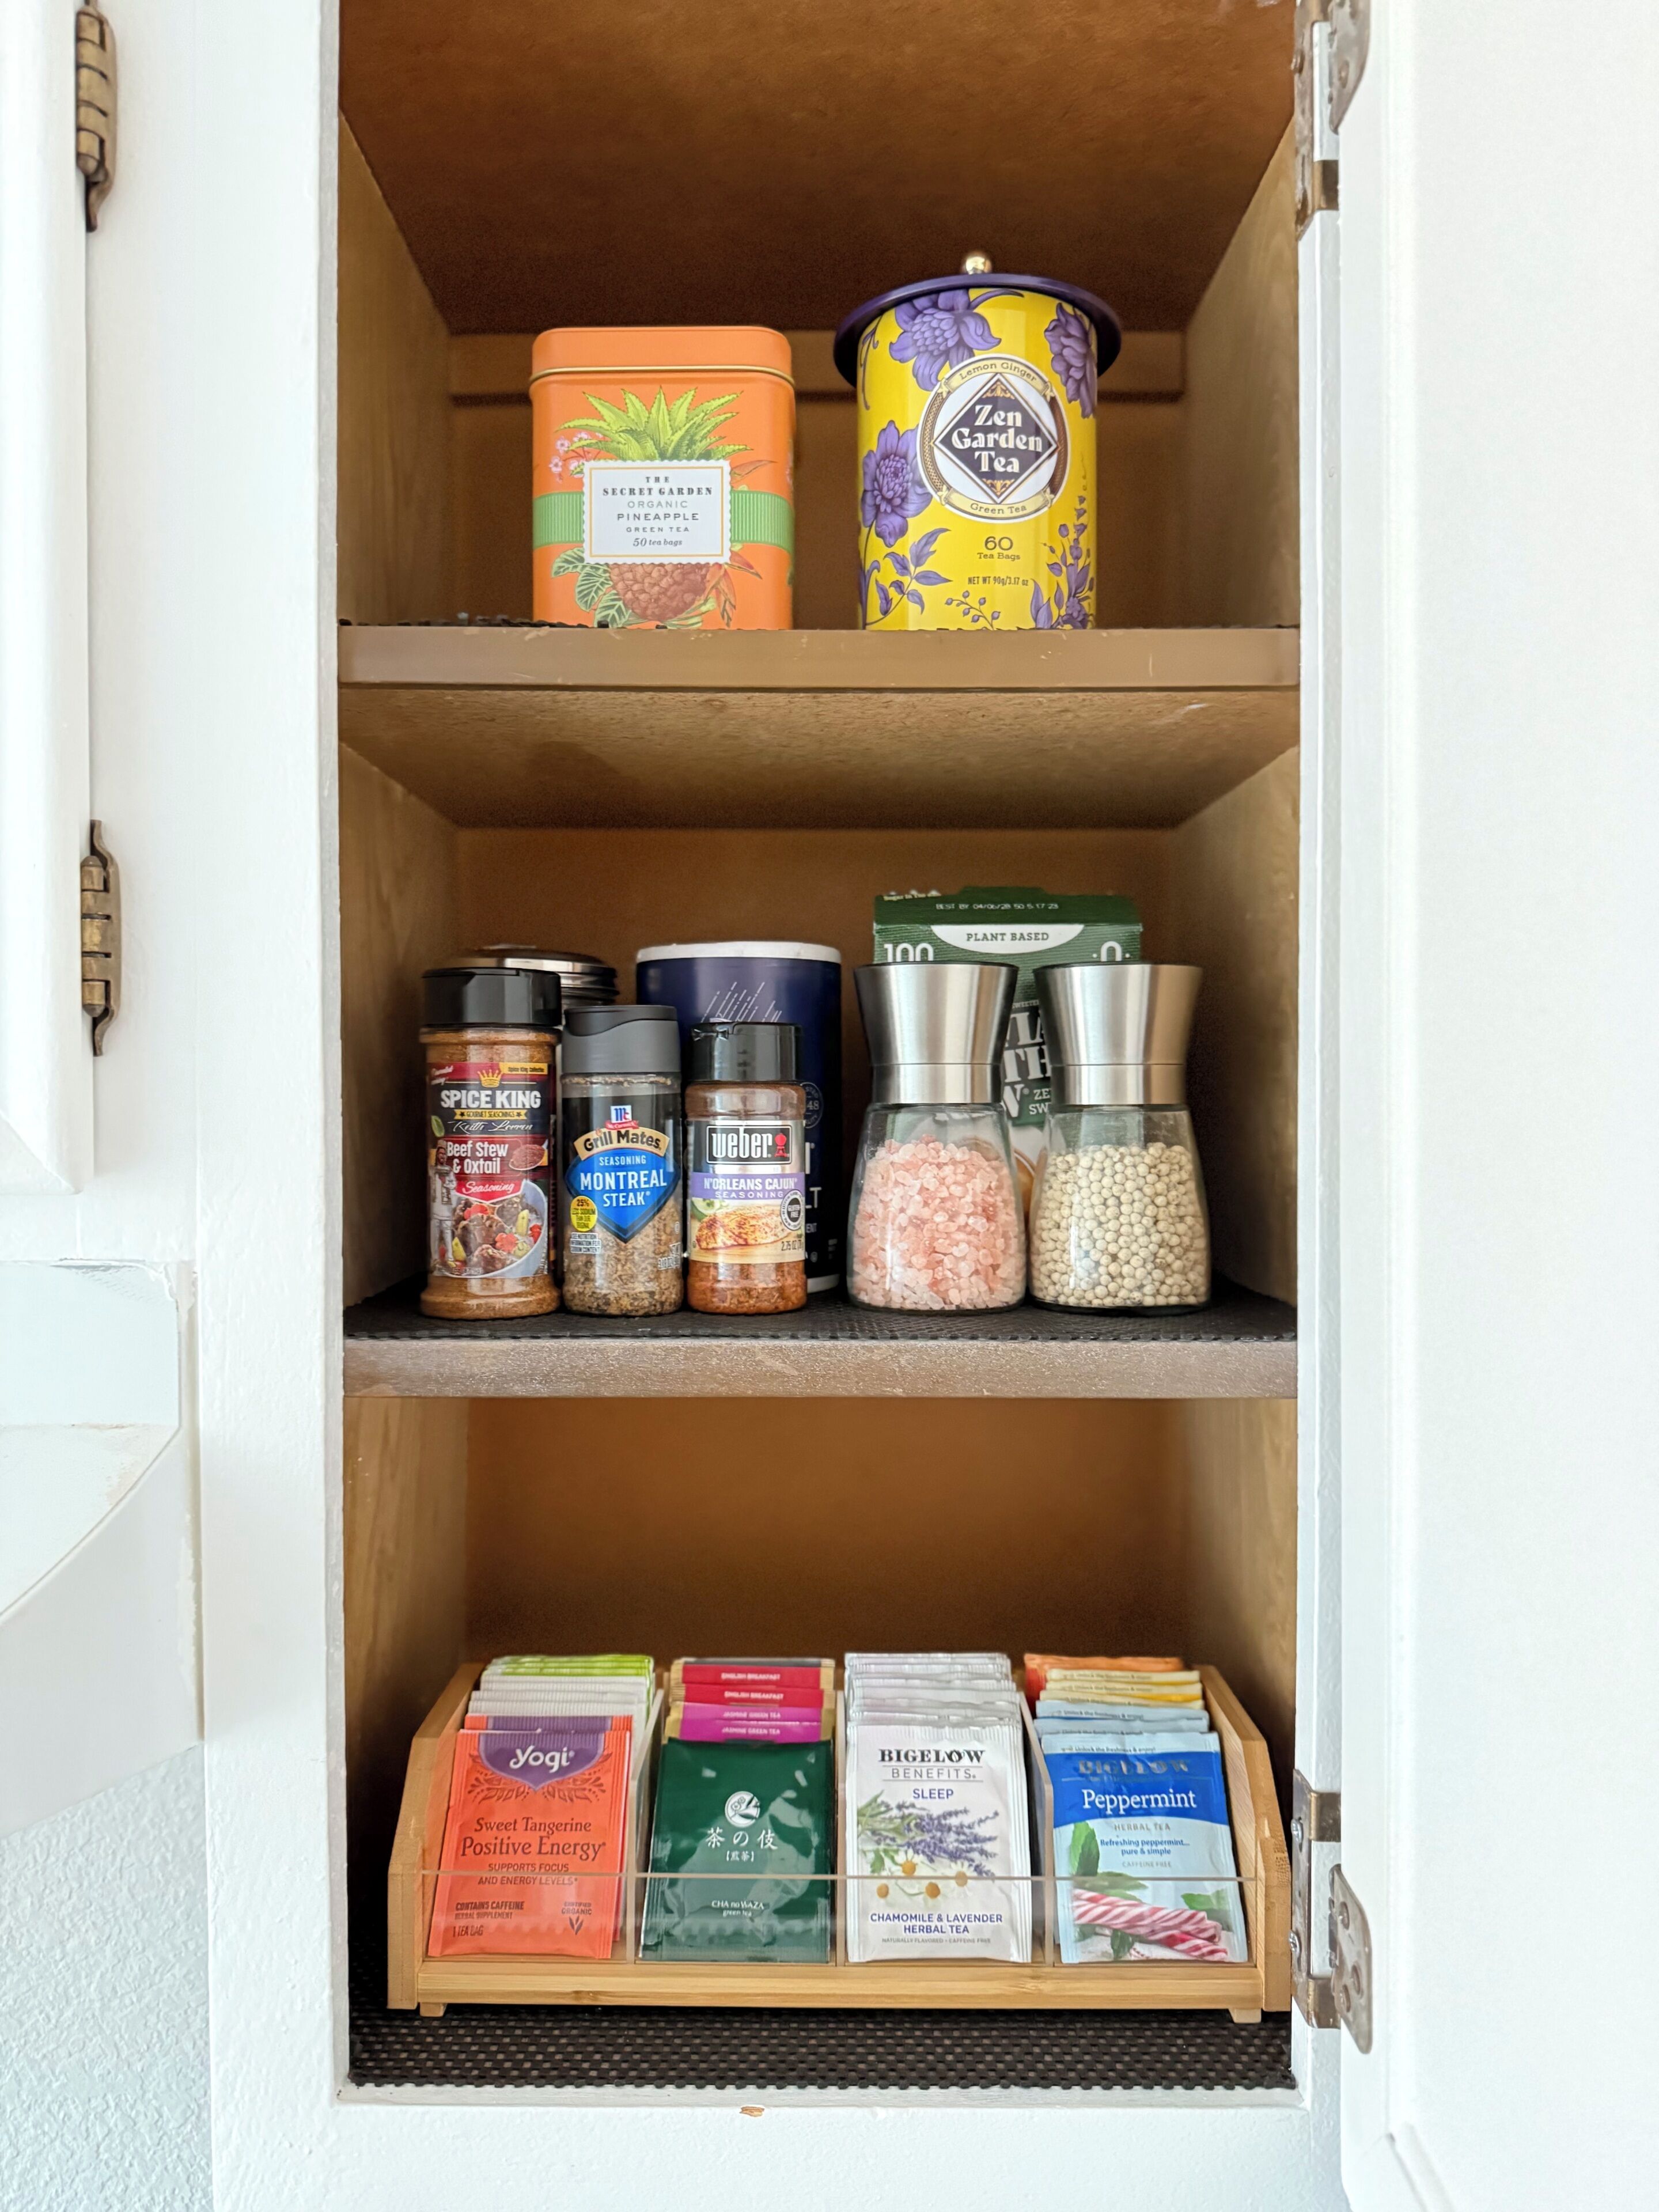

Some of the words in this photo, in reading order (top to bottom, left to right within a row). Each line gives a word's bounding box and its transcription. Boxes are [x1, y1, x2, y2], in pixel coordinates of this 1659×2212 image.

[959, 363, 997, 380] Lemon
[1001, 362, 1037, 382] Ginger
[974, 404, 1022, 427] Zen
[952, 427, 1043, 452] Garden
[974, 450, 1020, 473] Tea
[603, 488, 653, 496] SECRET
[658, 487, 713, 495] GARDEN
[970, 503, 1005, 514] Green
[1007, 505, 1027, 514] Tea
[632, 537, 647, 547] 50
[663, 539, 683, 547] bags
[984, 536, 1013, 551] 60
[997, 552, 1021, 562] Bags
[968, 577, 980, 585] NET
[966, 933, 1007, 942] PLANT
[1010, 932, 1050, 941] BASED
[440, 1090, 492, 1109] SPICE
[495, 1090, 541, 1109] KING
[584, 1130, 613, 1152] Grill
[616, 1130, 661, 1149] Mates
[711, 1126, 773, 1159] weber
[447, 1141, 473, 1157] Beef
[475, 1141, 509, 1157] Stew
[452, 1158, 461, 1173] &
[464, 1157, 501, 1174] Oxtail
[599, 1155, 647, 1166] SEASONING
[579, 1168, 668, 1191] MONTREAL
[703, 1177, 763, 1191] N'ORLEANS
[462, 1181, 515, 1194] Seasoning
[603, 1191, 646, 1207] STEAK
[715, 1191, 784, 1199] SEASONING
[747, 1672, 781, 1680] BREAKFAST
[724, 1691, 750, 1699] ENGLISH
[750, 1692, 784, 1700] BREAKFAST
[878, 1749, 986, 1764] BIGELOW
[892, 1768, 972, 1779] BENEFITS
[912, 1788, 954, 1800] SLEEP
[1081, 1787, 1198, 1815] Peppermint
[474, 1817, 517, 1832] Sweet
[522, 1816, 592, 1835] Tangerine
[1113, 1823, 1151, 1832] HERBAL
[1153, 1823, 1171, 1831] TEA
[460, 1836, 532, 1857] Positive
[1100, 1838, 1139, 1847] Refreshing
[1121, 1849, 1138, 1857] pure
[1147, 1847, 1171, 1857] simple
[488, 1863, 536, 1872] SUPPORTS
[539, 1863, 569, 1872] FOCUS
[478, 1876, 498, 1885] AND
[500, 1876, 538, 1885] ENERGY
[456, 1901, 490, 1911] CONTAINS
[491, 1901, 525, 1910] CAFFEINE
[711, 1900, 729, 1908] CHA
[476, 1911, 513, 1919] SUPPLEMENT
[870, 1913, 934, 1922] CHAMOMILE
[937, 1914, 944, 1922] &
[946, 1914, 1003, 1923] LAVENDER
[457, 1926, 469, 1937] TEA
[469, 1925, 484, 1937] BAG
[903, 1925, 946, 1934] HERBAL
[950, 1925, 970, 1934] TEA
